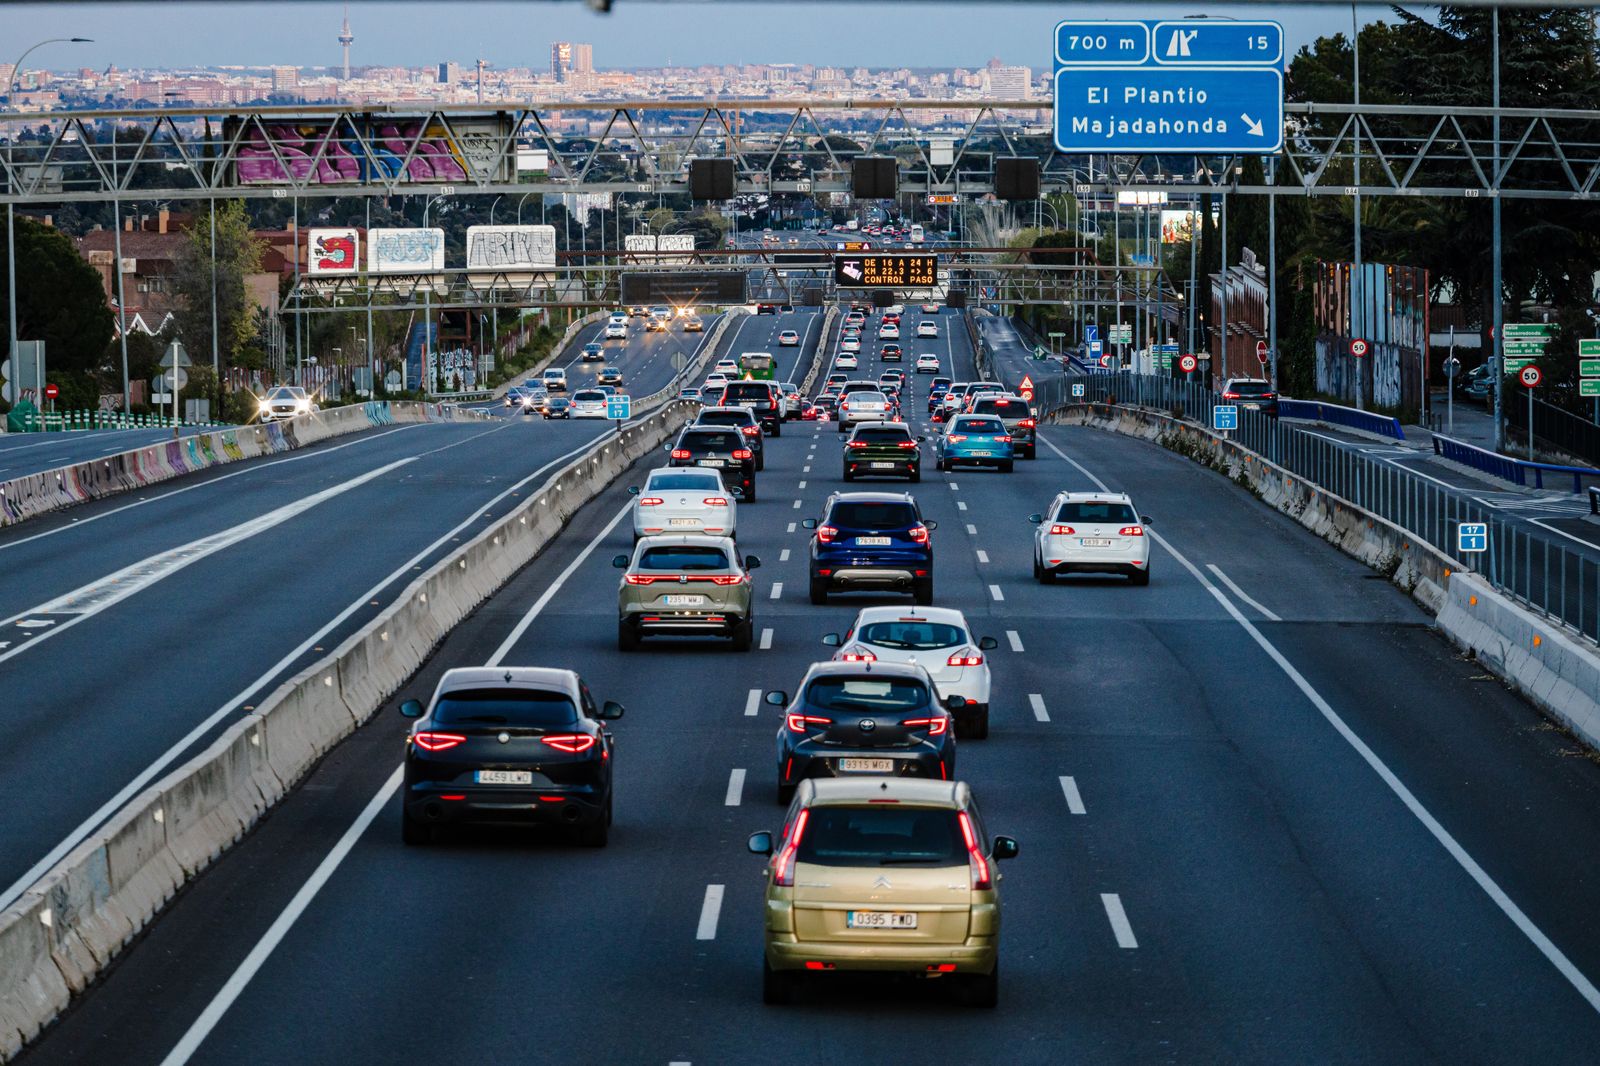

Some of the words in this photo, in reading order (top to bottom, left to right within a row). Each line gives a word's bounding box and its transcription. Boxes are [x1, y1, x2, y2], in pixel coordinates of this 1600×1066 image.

[1069, 35, 1107, 50] 700
[1119, 38, 1135, 50] m
[1247, 35, 1269, 50] 15
[1087, 87, 1108, 104] El
[1124, 87, 1207, 104] Plantio
[1072, 116, 1228, 138] Majadahonda
[864, 259, 876, 267] DE
[882, 259, 893, 267] 16
[899, 259, 905, 267] A
[910, 259, 921, 267] 24
[927, 259, 933, 267] H
[864, 276, 904, 284] CONTROL
[910, 276, 933, 284] PASO
[1524, 372, 1538, 381] 50
[614, 409, 623, 417] 17
[1222, 419, 1231, 427] 17
[1466, 526, 1479, 534] 17
[1470, 537, 1476, 548] 1
[846, 760, 870, 770] 9315
[482, 771, 507, 782] 4459
[857, 913, 886, 925] 0395
[891, 914, 913, 926] FWD
